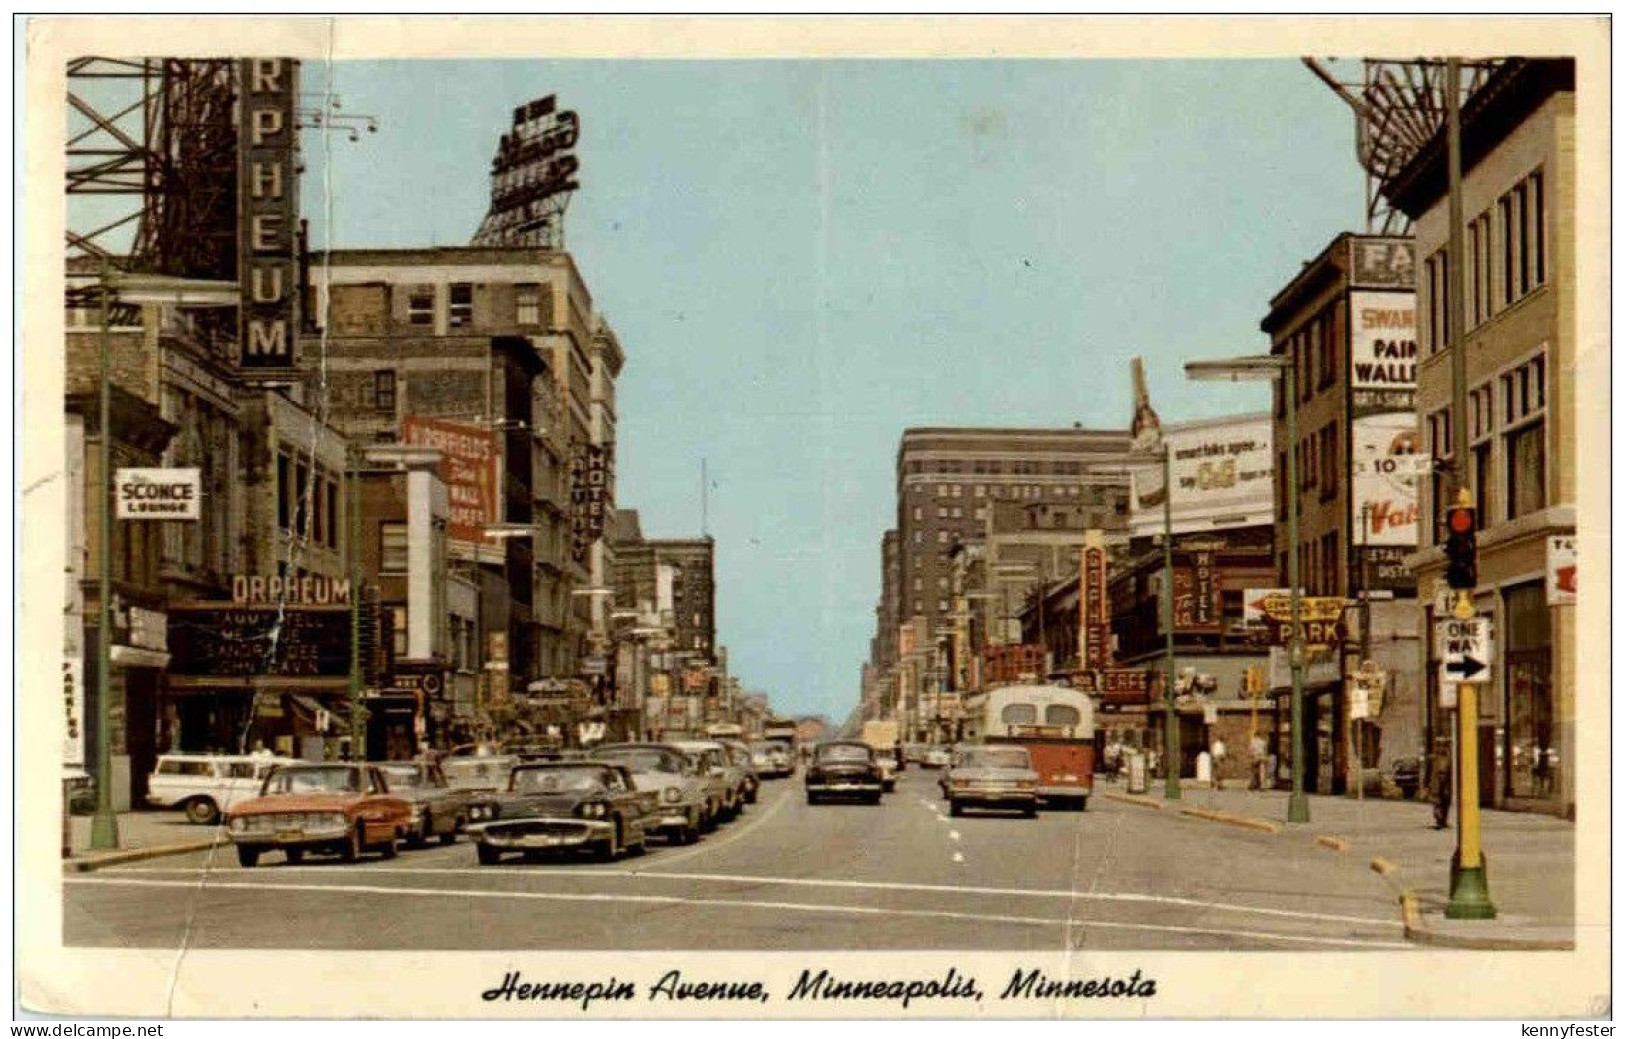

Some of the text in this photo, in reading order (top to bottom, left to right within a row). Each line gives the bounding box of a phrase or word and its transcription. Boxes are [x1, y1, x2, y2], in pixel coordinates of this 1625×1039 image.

[252, 58, 286, 355] RPHEUM
[122, 482, 193, 500] SCONCE
[589, 452, 605, 531] HOTEL
[127, 502, 188, 512] LOUNGE
[233, 576, 350, 603] ORPHEUM
[1281, 622, 1338, 641] PARK
[1448, 623, 1481, 638] ONE
[1448, 639, 1481, 653] WAY
